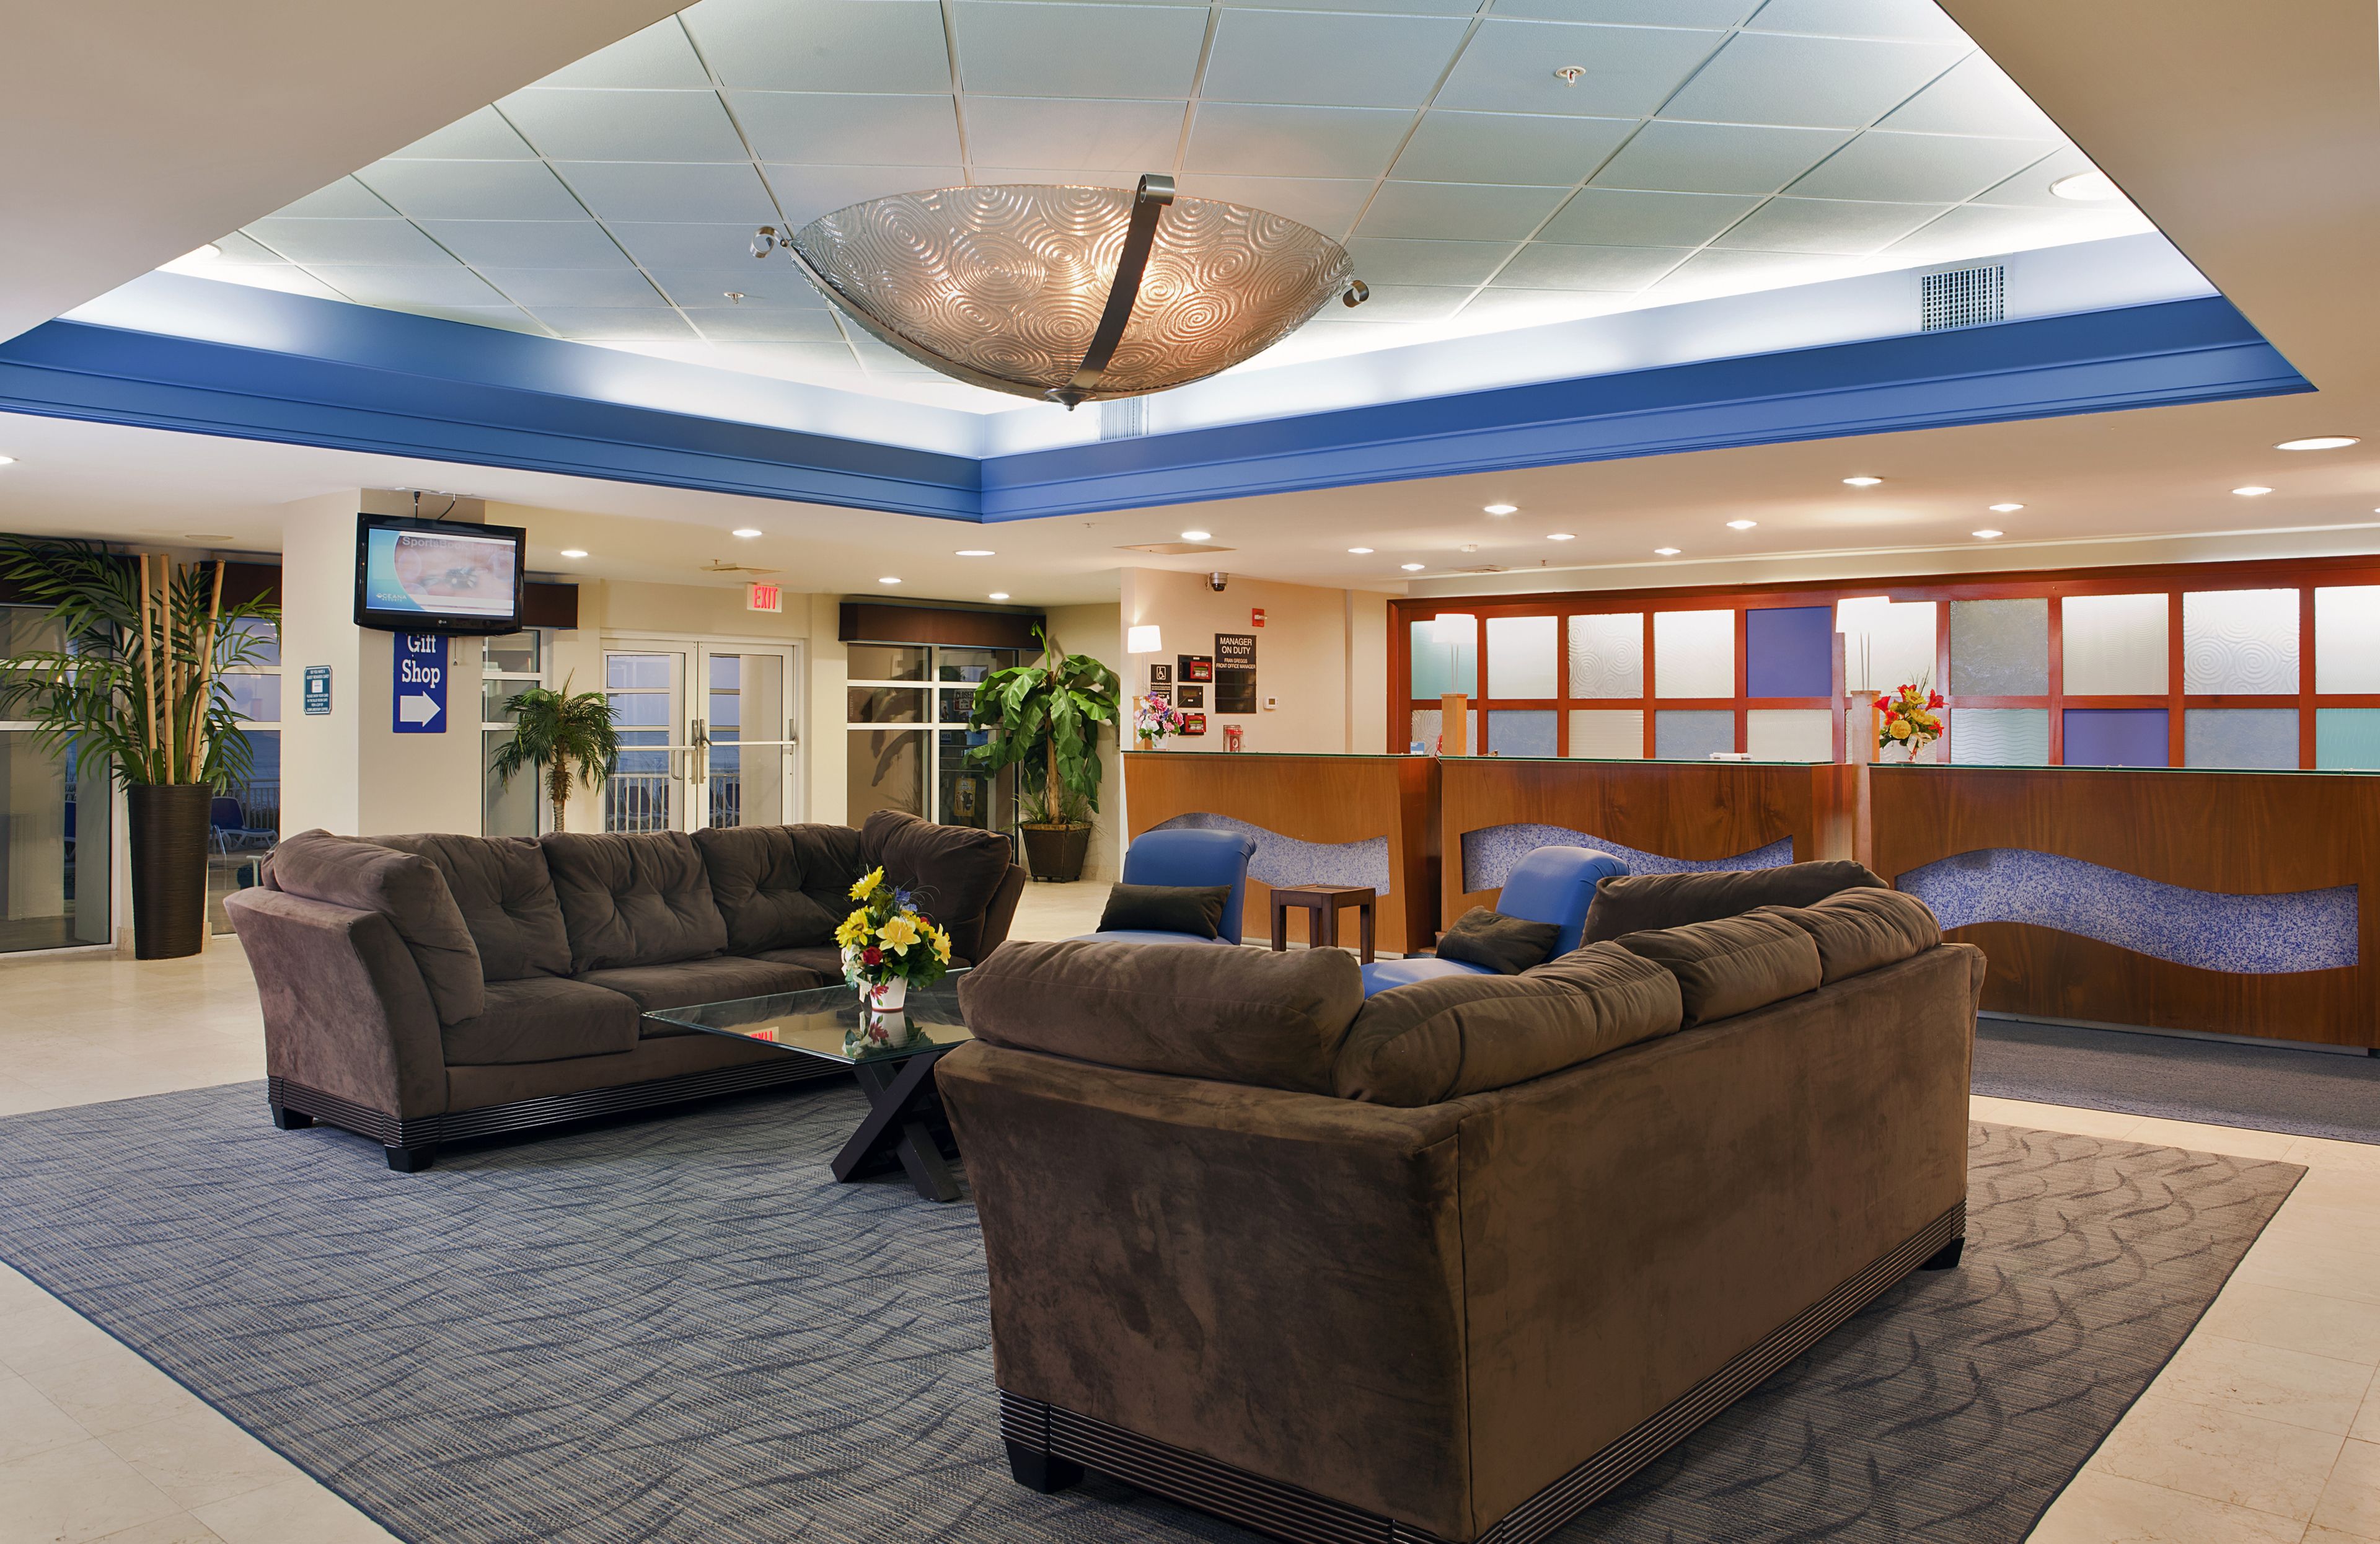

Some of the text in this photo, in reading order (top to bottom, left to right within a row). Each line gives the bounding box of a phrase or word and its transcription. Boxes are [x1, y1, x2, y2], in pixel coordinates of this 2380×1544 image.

[753, 585, 778, 609] EXIT
[407, 634, 436, 653] Gift
[1220, 637, 1253, 646] MANAGER
[1222, 646, 1251, 655] ON DUTY
[402, 659, 441, 689] Shop
[956, 691, 974, 700] CLOSED
